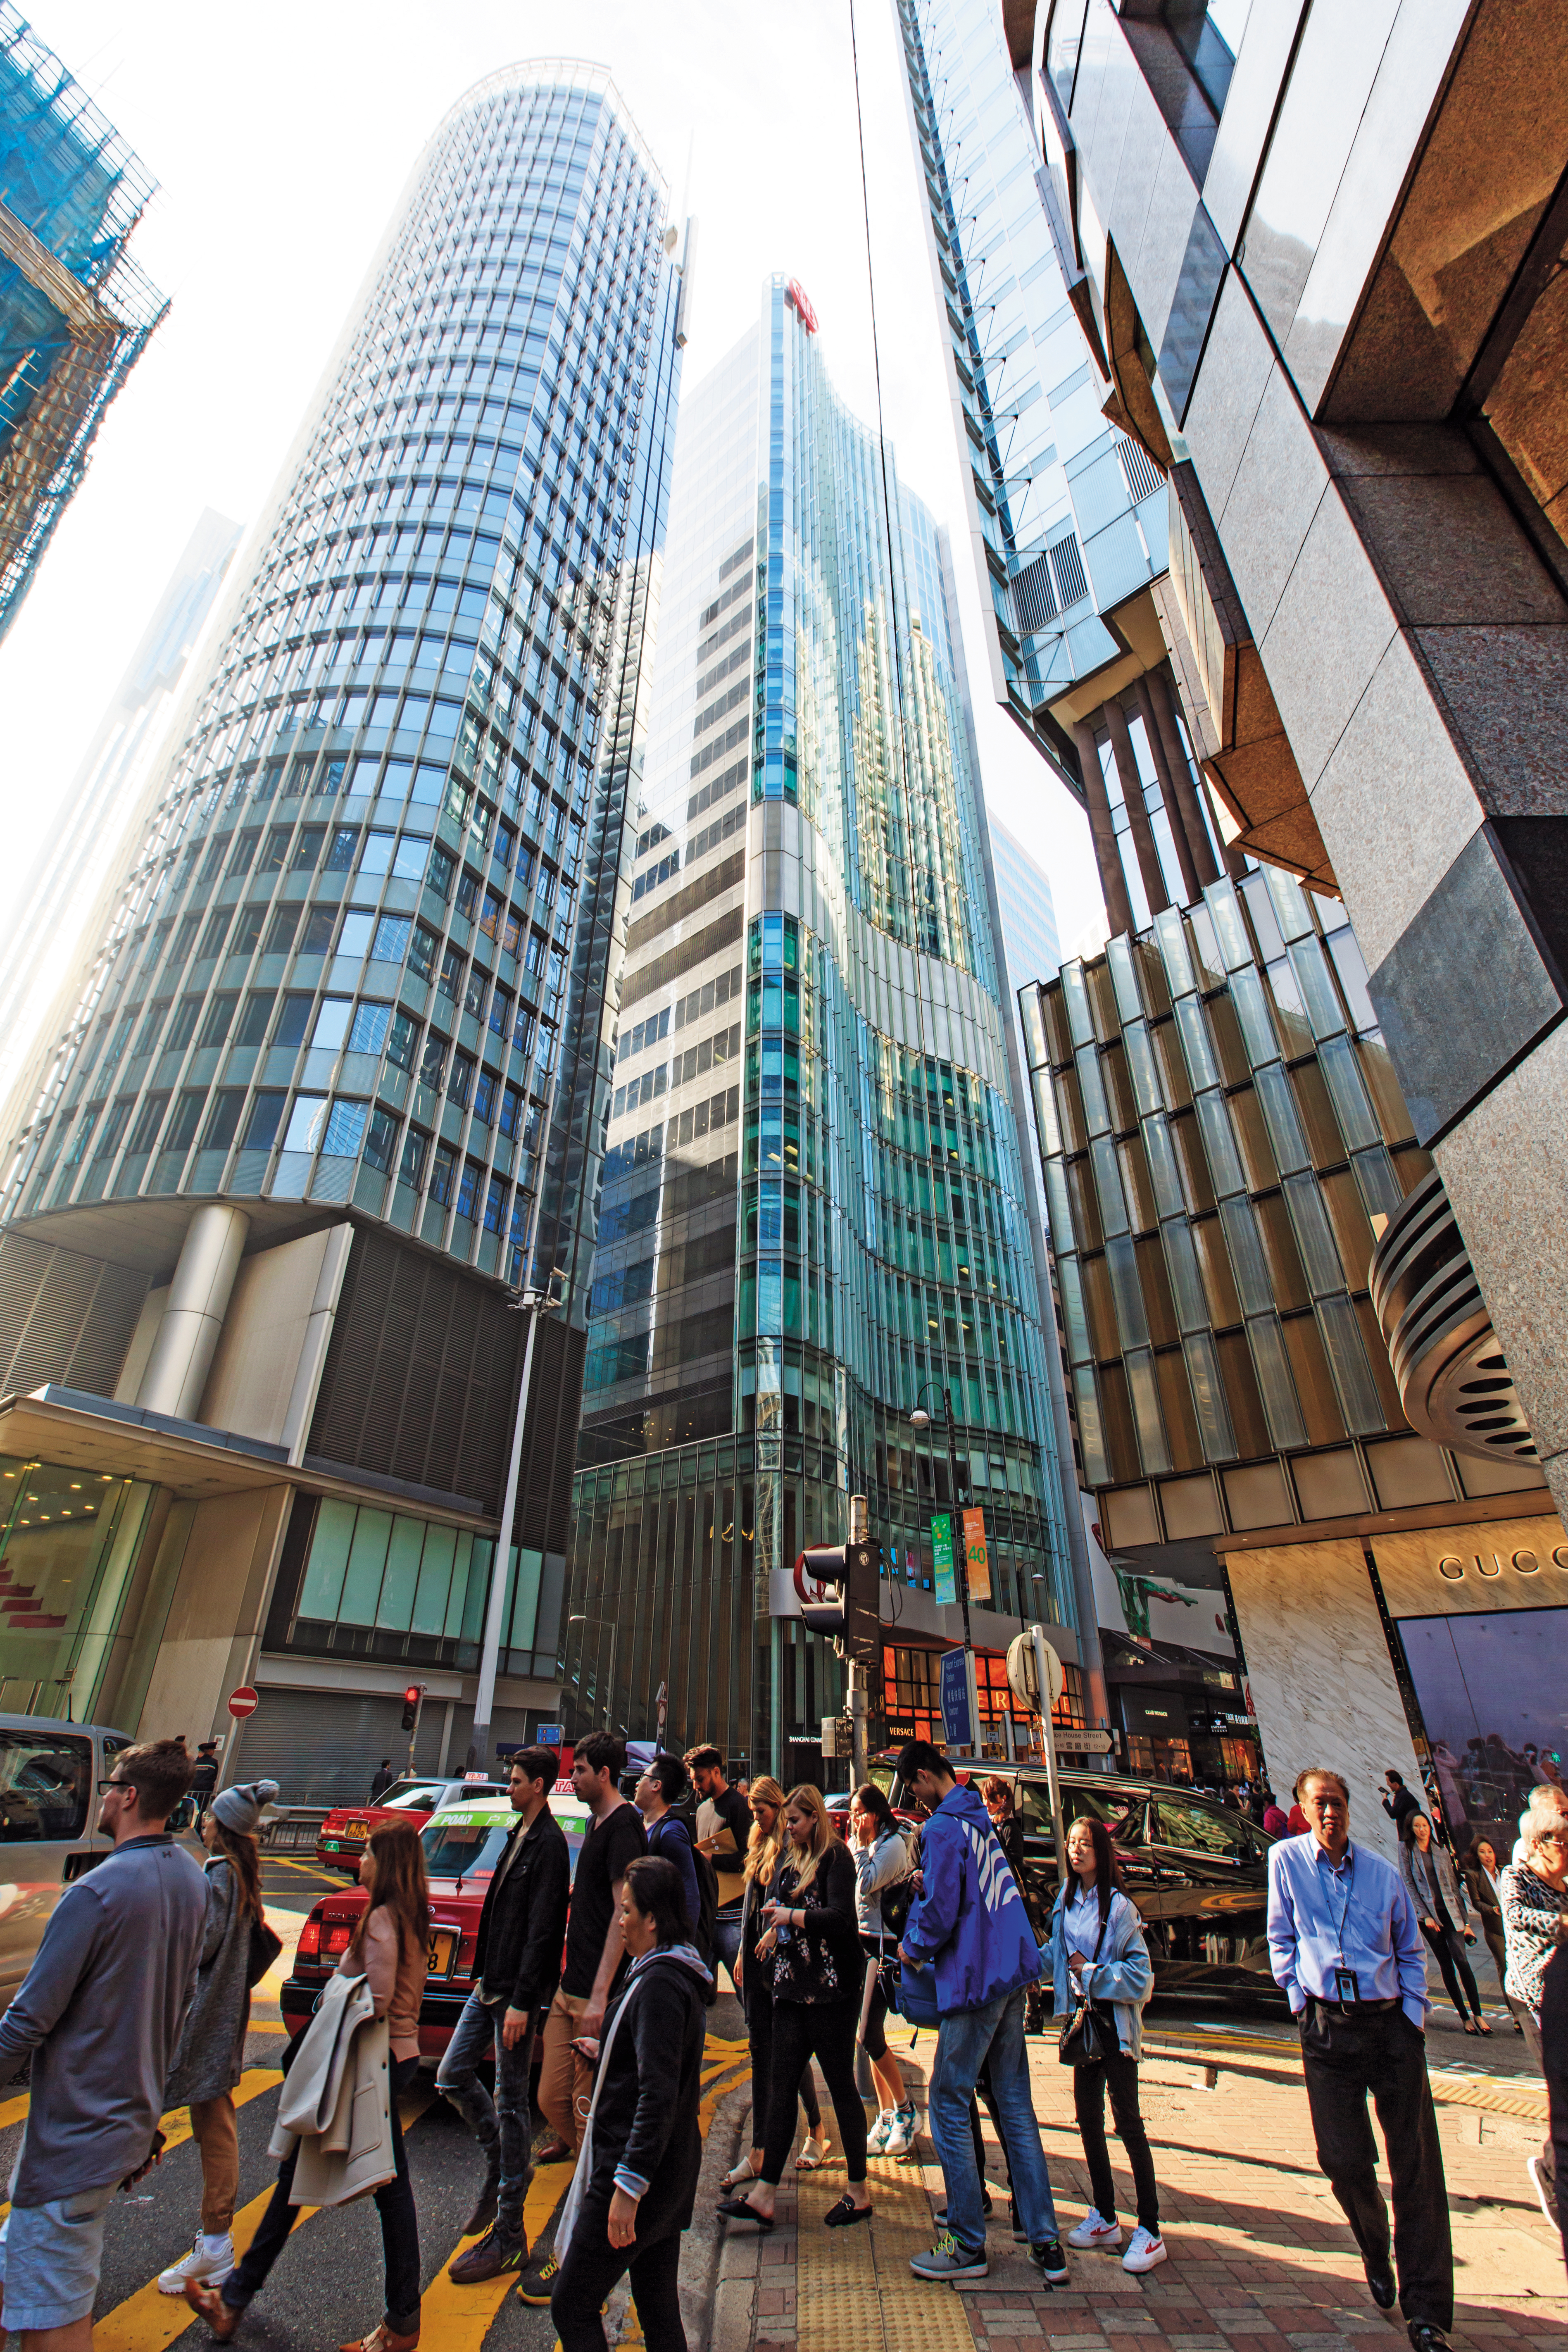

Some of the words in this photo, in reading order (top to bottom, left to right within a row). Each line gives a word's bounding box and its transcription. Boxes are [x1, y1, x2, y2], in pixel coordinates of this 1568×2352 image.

[968, 1545, 985, 1564] 40
[945, 1659, 954, 1671] Airport
[954, 1657, 964, 1669] Express
[946, 1673, 955, 1683] Station
[948, 1706, 959, 1715] Kowloon
[890, 1727, 914, 1736] VERSACE
[1066, 1742, 1090, 1750] 雪廠街
[440, 1814, 473, 1825] POAD
